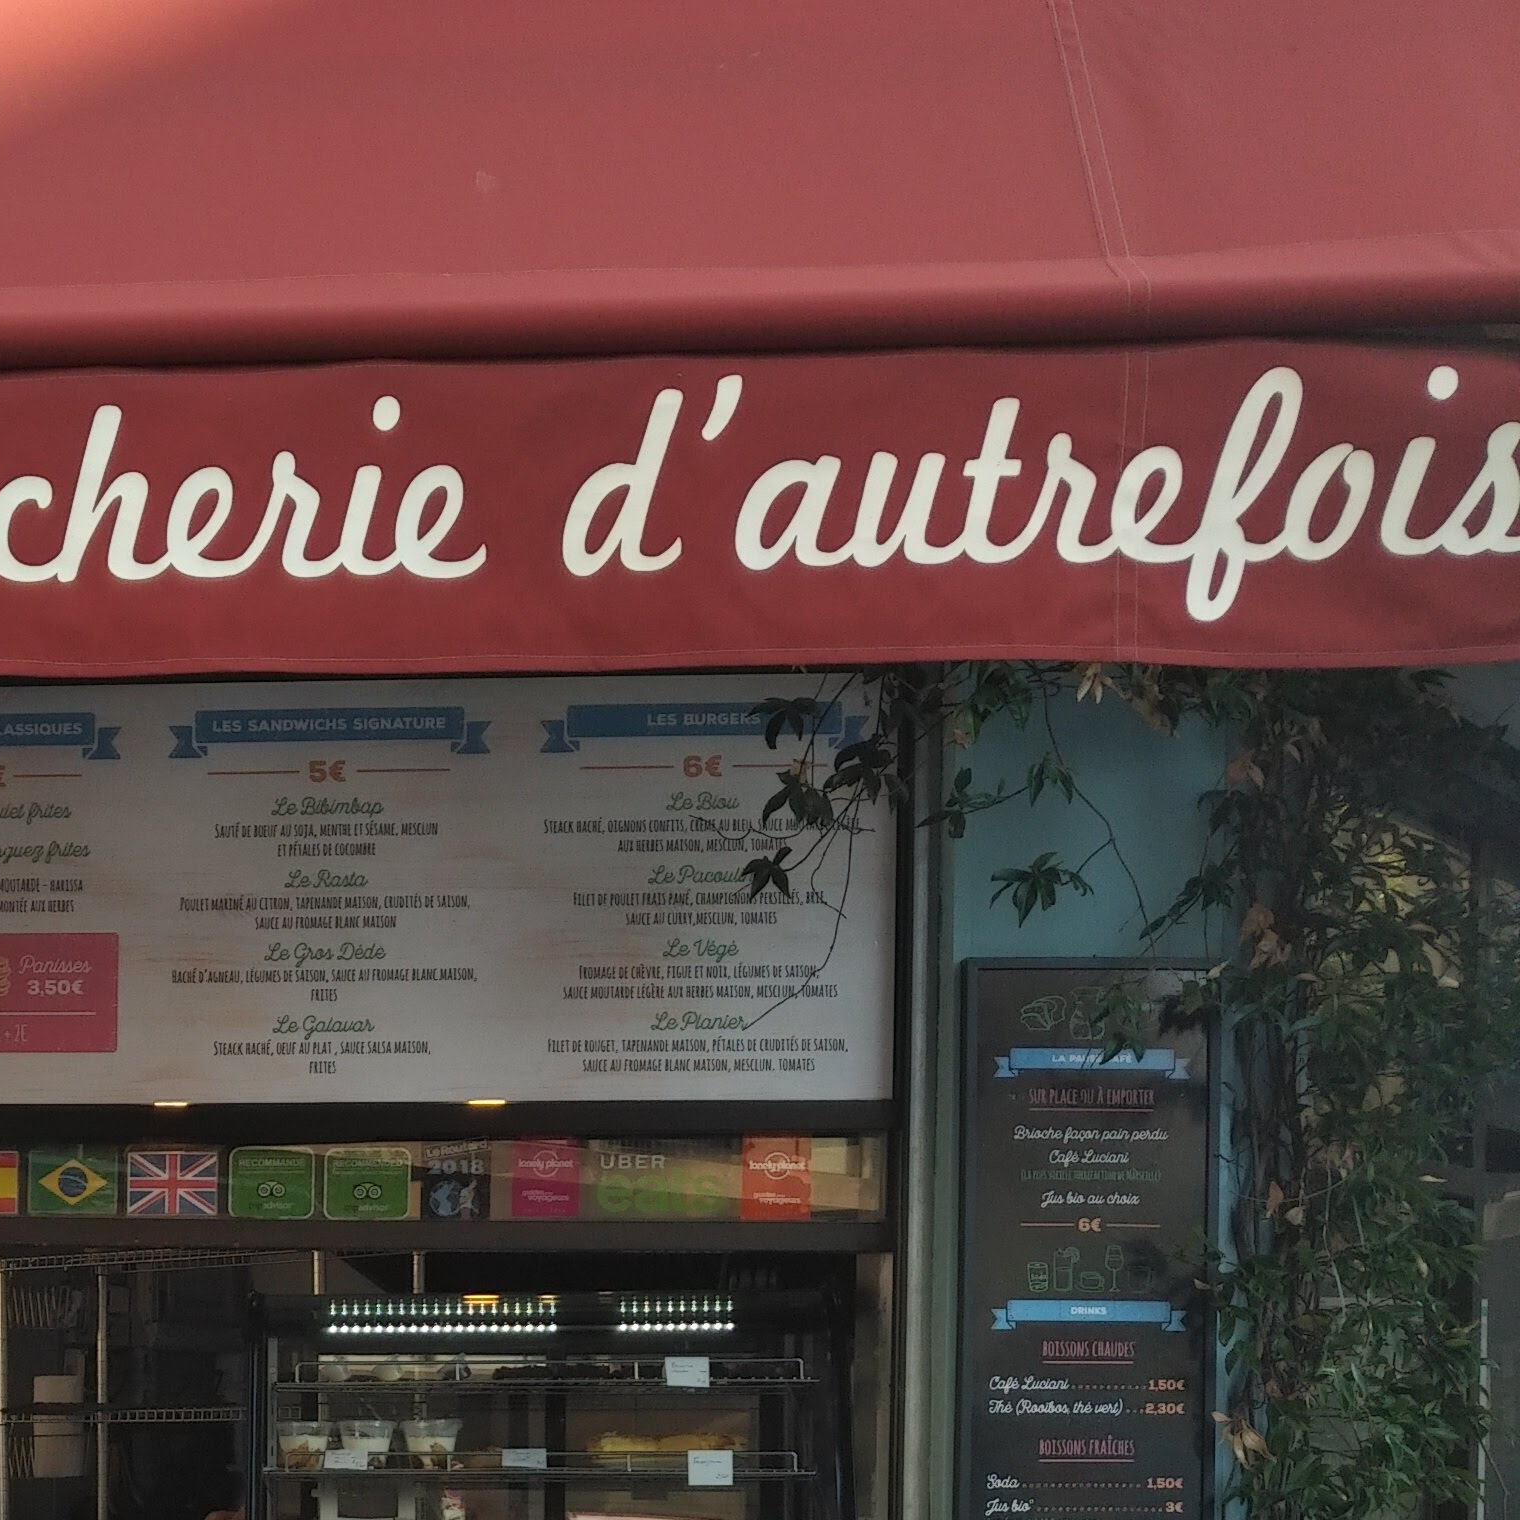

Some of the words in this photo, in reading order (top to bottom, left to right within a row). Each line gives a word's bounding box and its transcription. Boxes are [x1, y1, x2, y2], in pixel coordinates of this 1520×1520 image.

[561, 365, 1520, 621] d'autrefois
[213, 720, 241, 732] LES
[248, 718, 347, 732] SANDWICHS
[353, 716, 446, 730] SIGNATURE
[646, 713, 677, 726] LES
[309, 760, 346, 783] 5€
[682, 755, 723, 778] 6€
[271, 796, 298, 816] Le
[301, 796, 384, 817] Bibimbap
[666, 791, 694, 811] Le
[26, 801, 72, 824] frites
[46, 840, 91, 864] frites
[284, 869, 312, 888] Le
[314, 869, 368, 888] Rasta
[647, 864, 676, 885] Le
[282, 916, 293, 929] AU
[296, 915, 332, 929] FROMAGE
[363, 915, 396, 928] MAISON
[264, 942, 290, 961] Le
[294, 942, 334, 968] Gros
[662, 938, 691, 958] Le
[18, 954, 92, 974] Panisses
[27, 979, 84, 996] 3,50€
[272, 1015, 300, 1034] Le
[302, 1015, 375, 1040] Galavar
[650, 1012, 679, 1031] Le
[680, 1011, 745, 1032] Planier
[1014, 1125, 1063, 1140] Brioche
[1063, 1127, 1100, 1144] façon
[1100, 1128, 1129, 1141] pain
[1129, 1128, 1169, 1141] perdu
[427, 1160, 485, 1175] 2018
[600, 1154, 666, 1169] UBER
[1049, 1150, 1080, 1167] Café
[1081, 1149, 1129, 1164] Luciani
[1040, 1191, 1064, 1208] Jus
[1066, 1192, 1085, 1204] bio
[1087, 1194, 1104, 1204] au
[1106, 1192, 1140, 1205] choix
[1077, 1217, 1102, 1233] 6€
[1070, 1307, 1107, 1315] DRINKS
[1042, 1341, 1089, 1357] BOISSONS
[1092, 1341, 1135, 1357] CHAUDES
[989, 1376, 1020, 1394] Café
[1021, 1375, 1070, 1390] Luciani
[1148, 1379, 1185, 1391] 1,50€
[988, 1399, 1013, 1414] Thé
[1073, 1399, 1093, 1414] thé
[1094, 1398, 1123, 1416] vert)
[1144, 1402, 1185, 1415] 2,30€
[1039, 1439, 1086, 1456] BOISSONS
[986, 1474, 1020, 1490] Soda
[1146, 1477, 1183, 1490] 1,50€
[985, 1498, 1010, 1516] Jus
[1165, 1501, 1183, 1513] 3€
